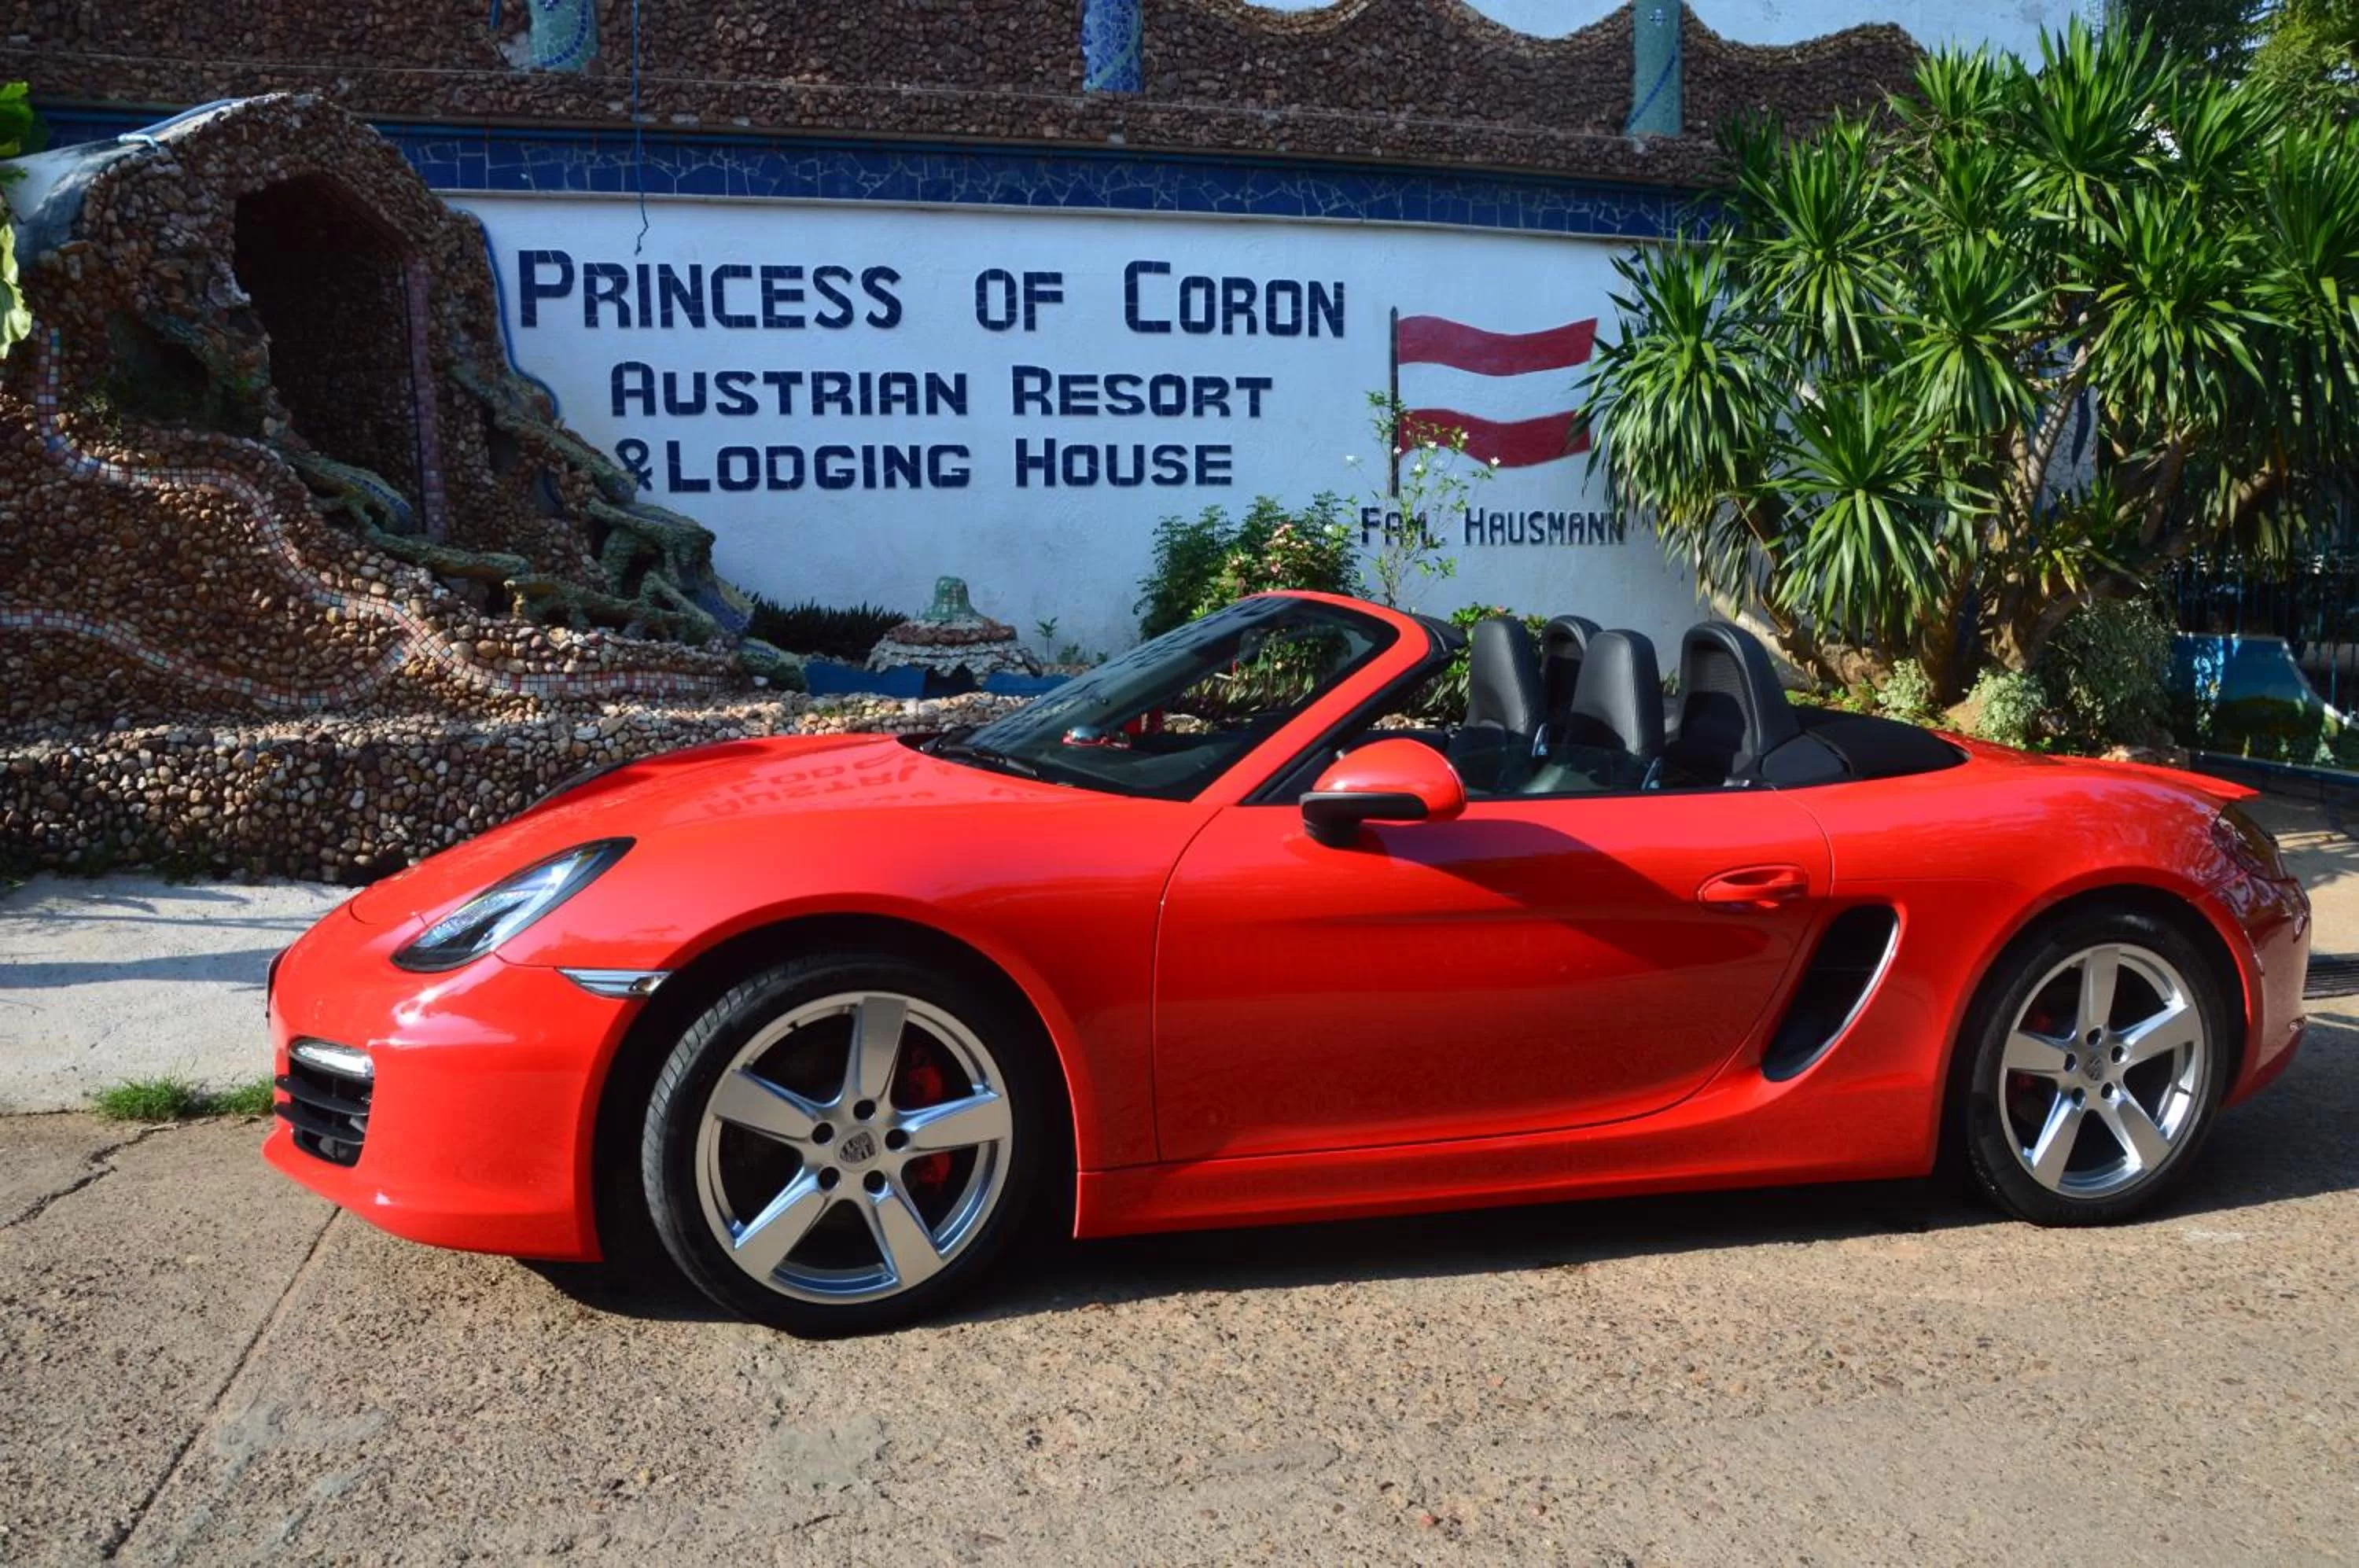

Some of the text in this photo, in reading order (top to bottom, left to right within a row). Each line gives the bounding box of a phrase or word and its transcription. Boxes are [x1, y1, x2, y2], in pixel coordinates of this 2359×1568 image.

[517, 249, 1345, 337] PRINCESS OF CORON
[610, 361, 1273, 418] AUSTRIAN RESORT
[1014, 437, 1232, 488] HOUSE
[1463, 506, 1627, 546] HAUSMANN
